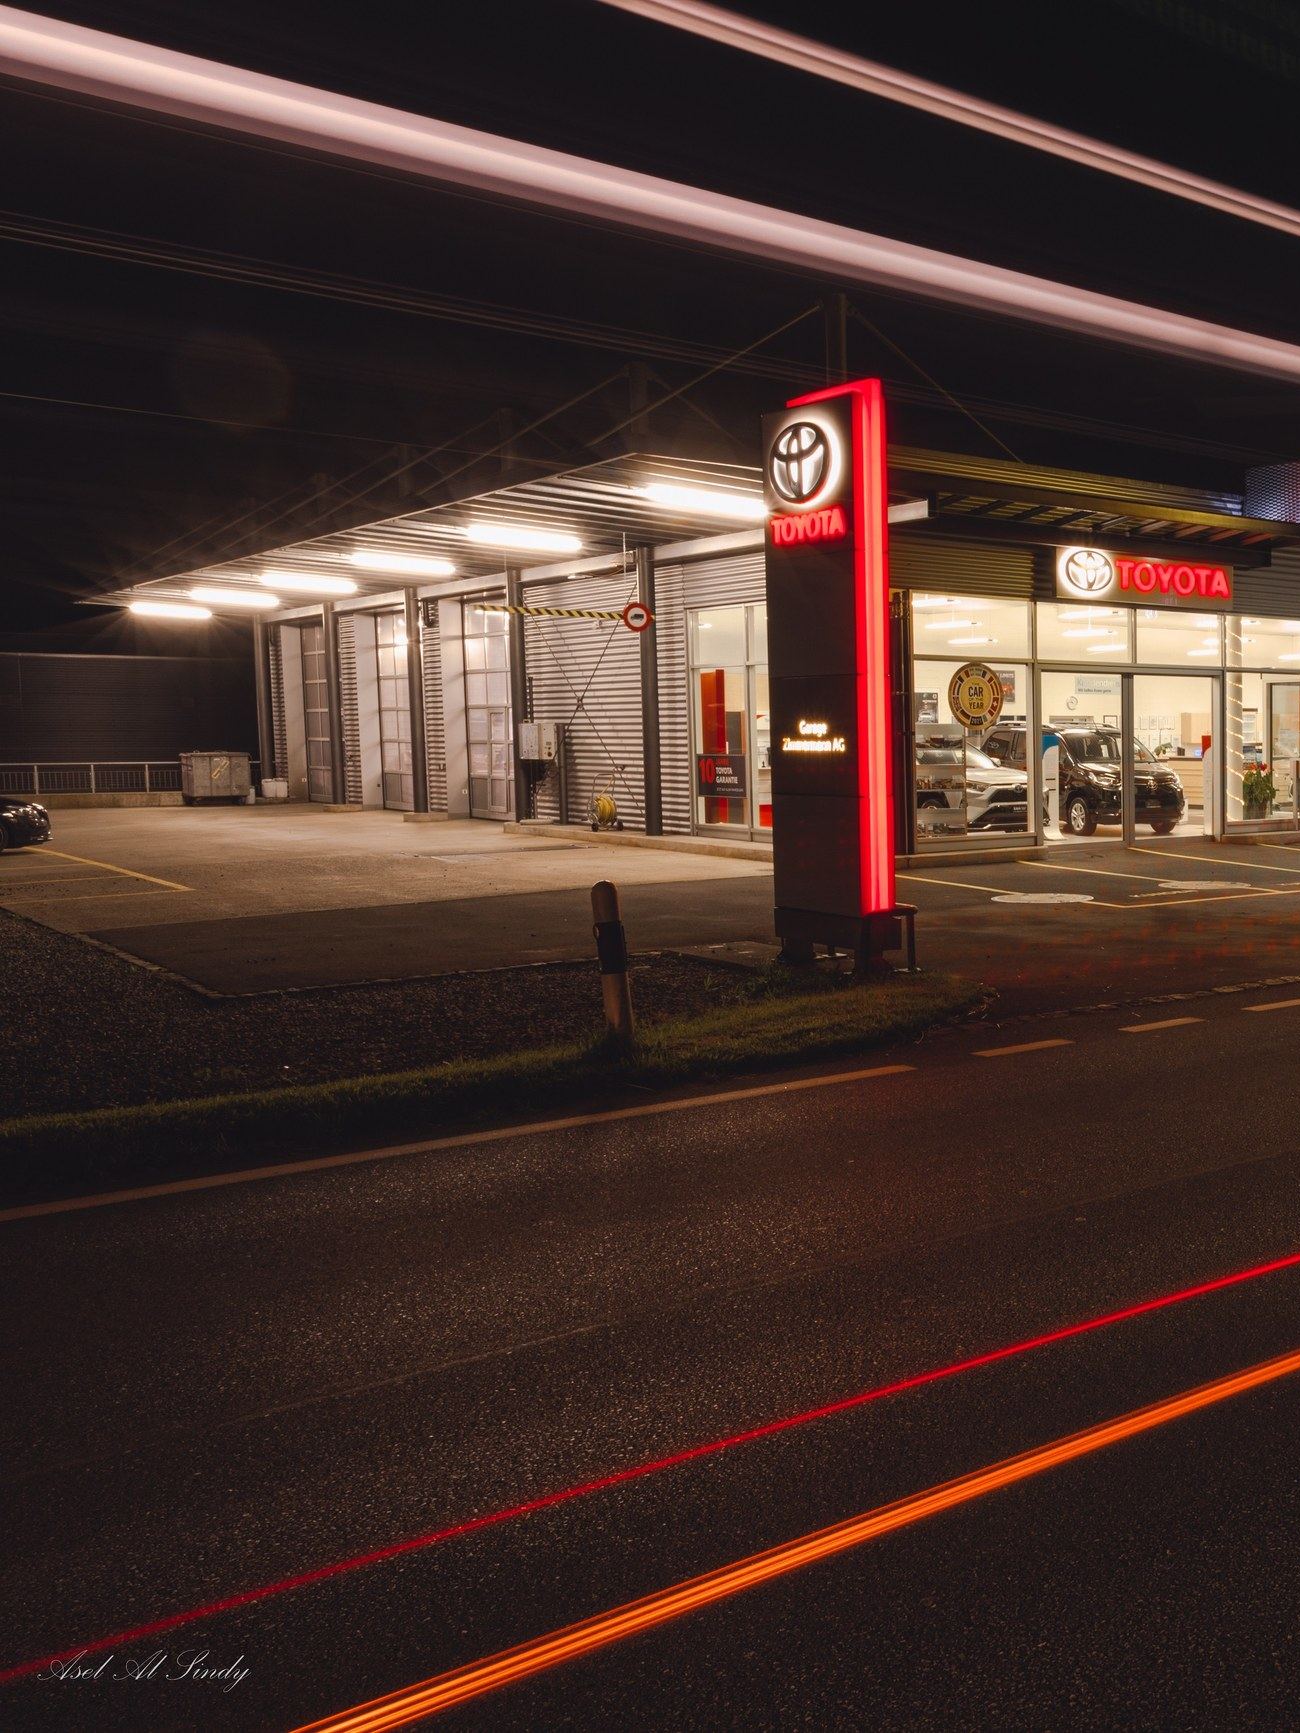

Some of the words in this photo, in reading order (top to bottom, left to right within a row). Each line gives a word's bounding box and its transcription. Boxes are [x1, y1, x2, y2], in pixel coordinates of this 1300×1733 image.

[770, 508, 846, 544] TOYOTA
[1115, 560, 1230, 598] TOYOTA
[968, 686, 984, 698] CAR
[969, 702, 984, 710] YEAR
[832, 737, 846, 752] AG
[699, 758, 716, 784] 10
[715, 767, 733, 775] TOYOTA
[715, 776, 738, 784] GARANTIE
